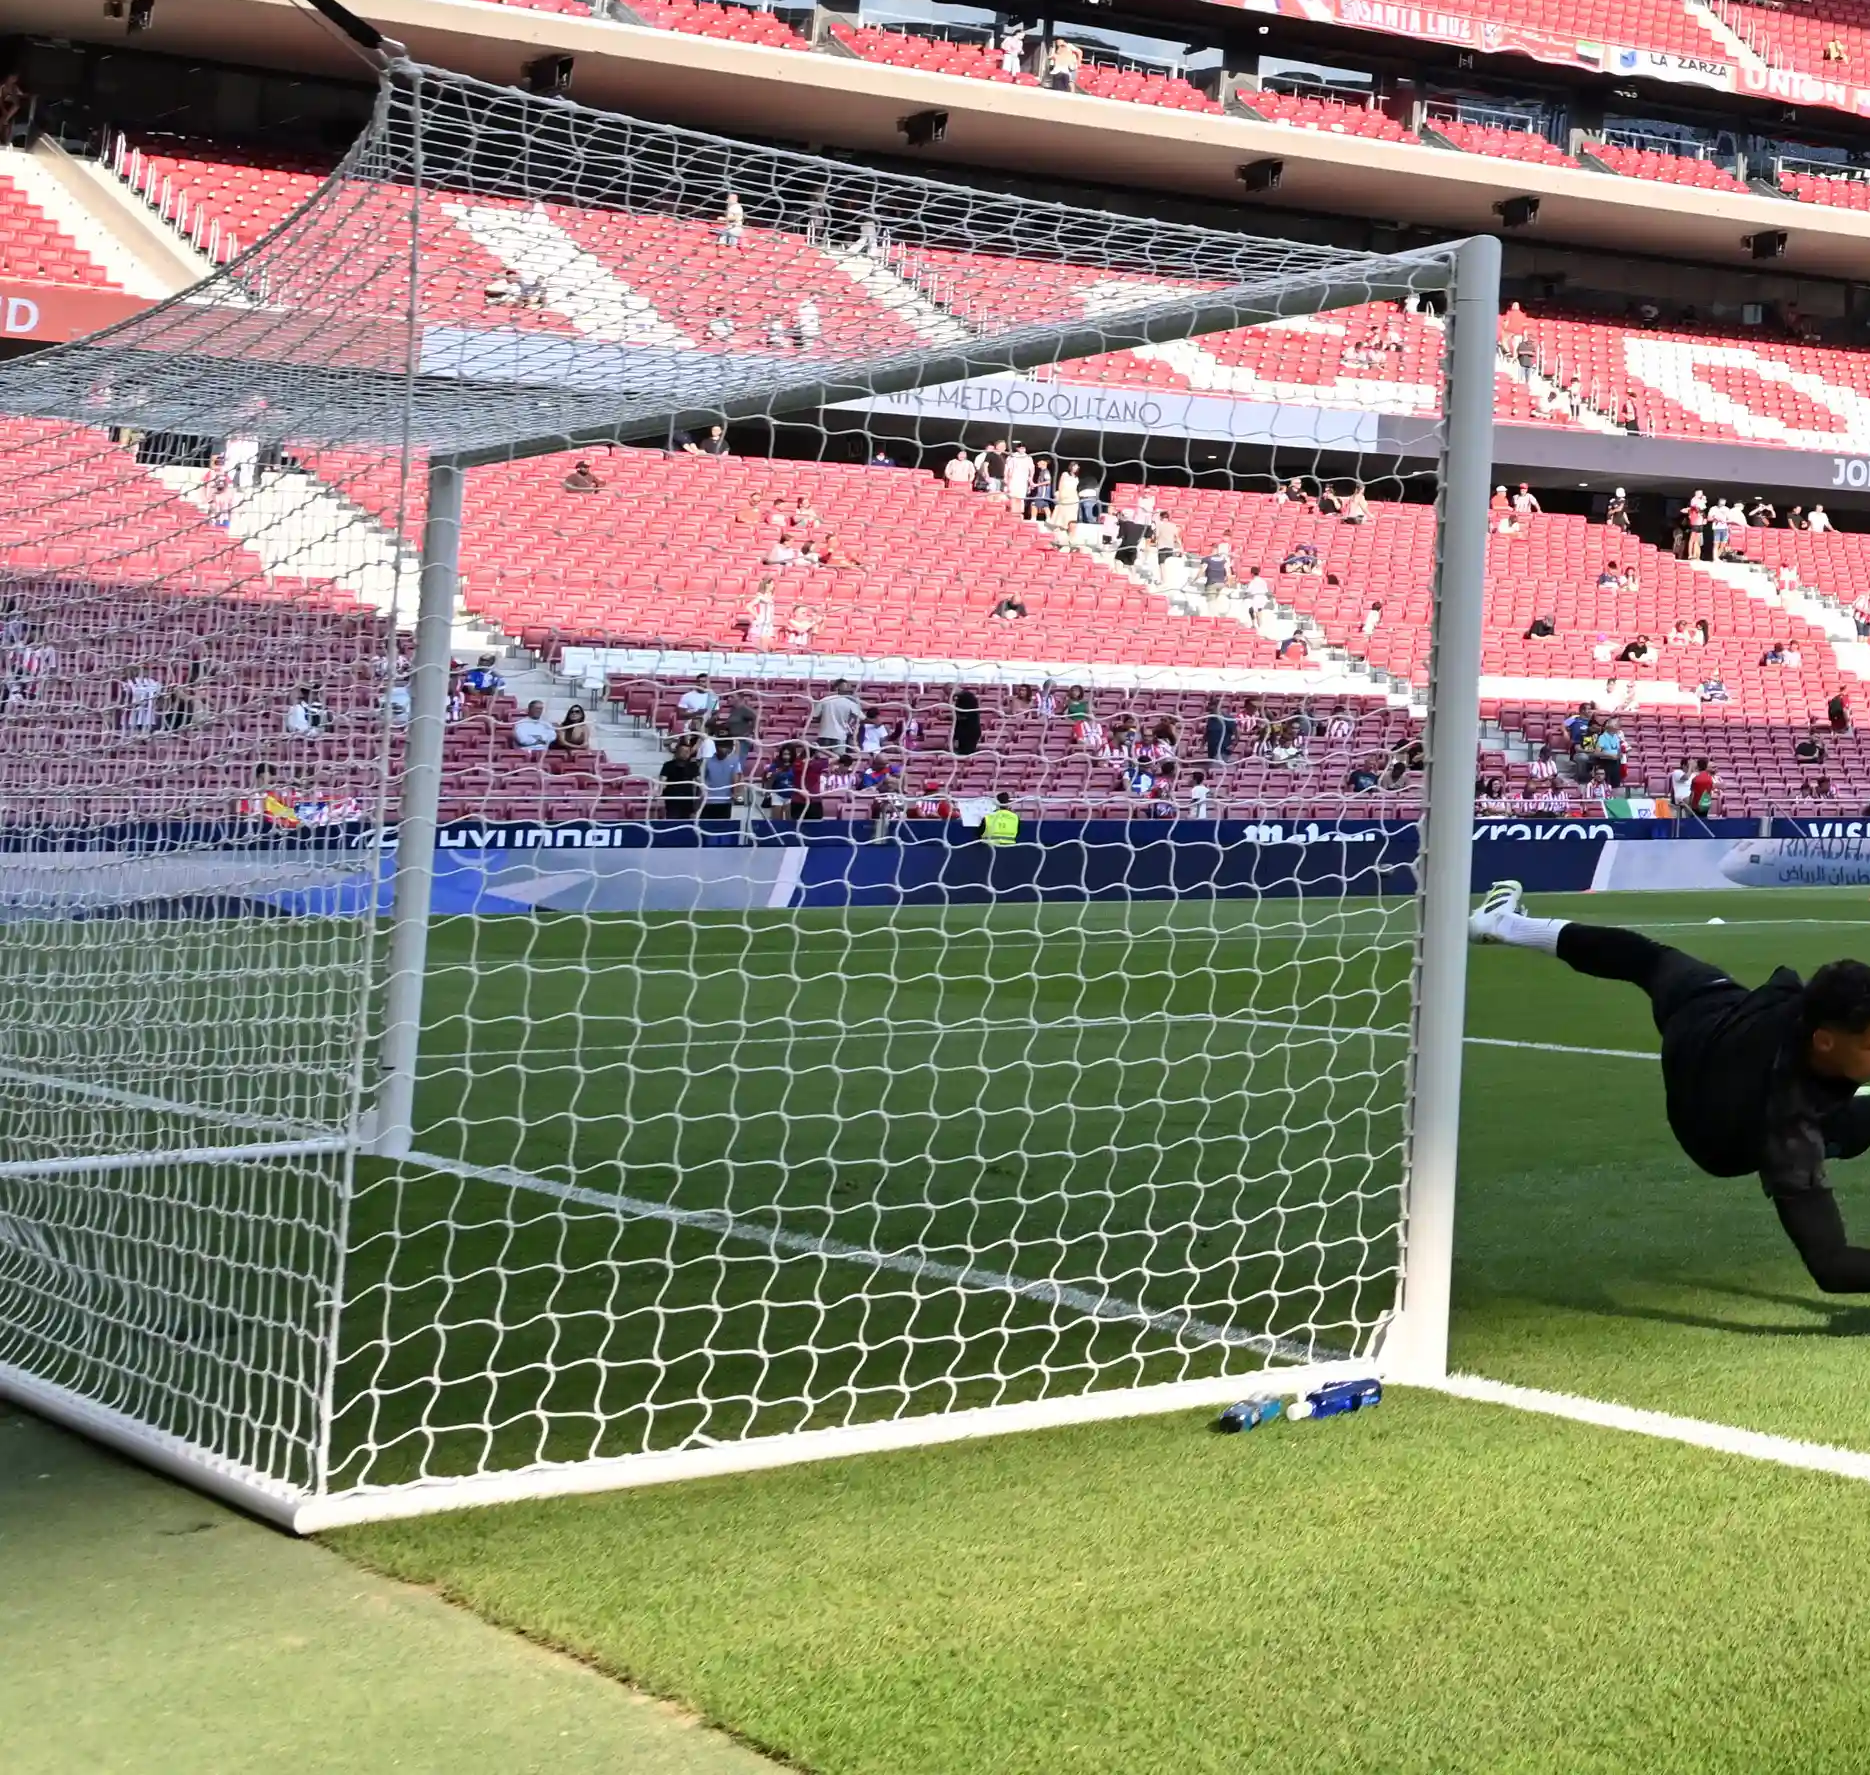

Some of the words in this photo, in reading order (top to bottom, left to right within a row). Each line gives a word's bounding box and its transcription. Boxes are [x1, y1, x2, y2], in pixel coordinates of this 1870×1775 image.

[1650, 52, 1668, 68] LA
[1678, 56, 1728, 78] ZARZA
[937, 384, 1163, 429] METROPOLITANO
